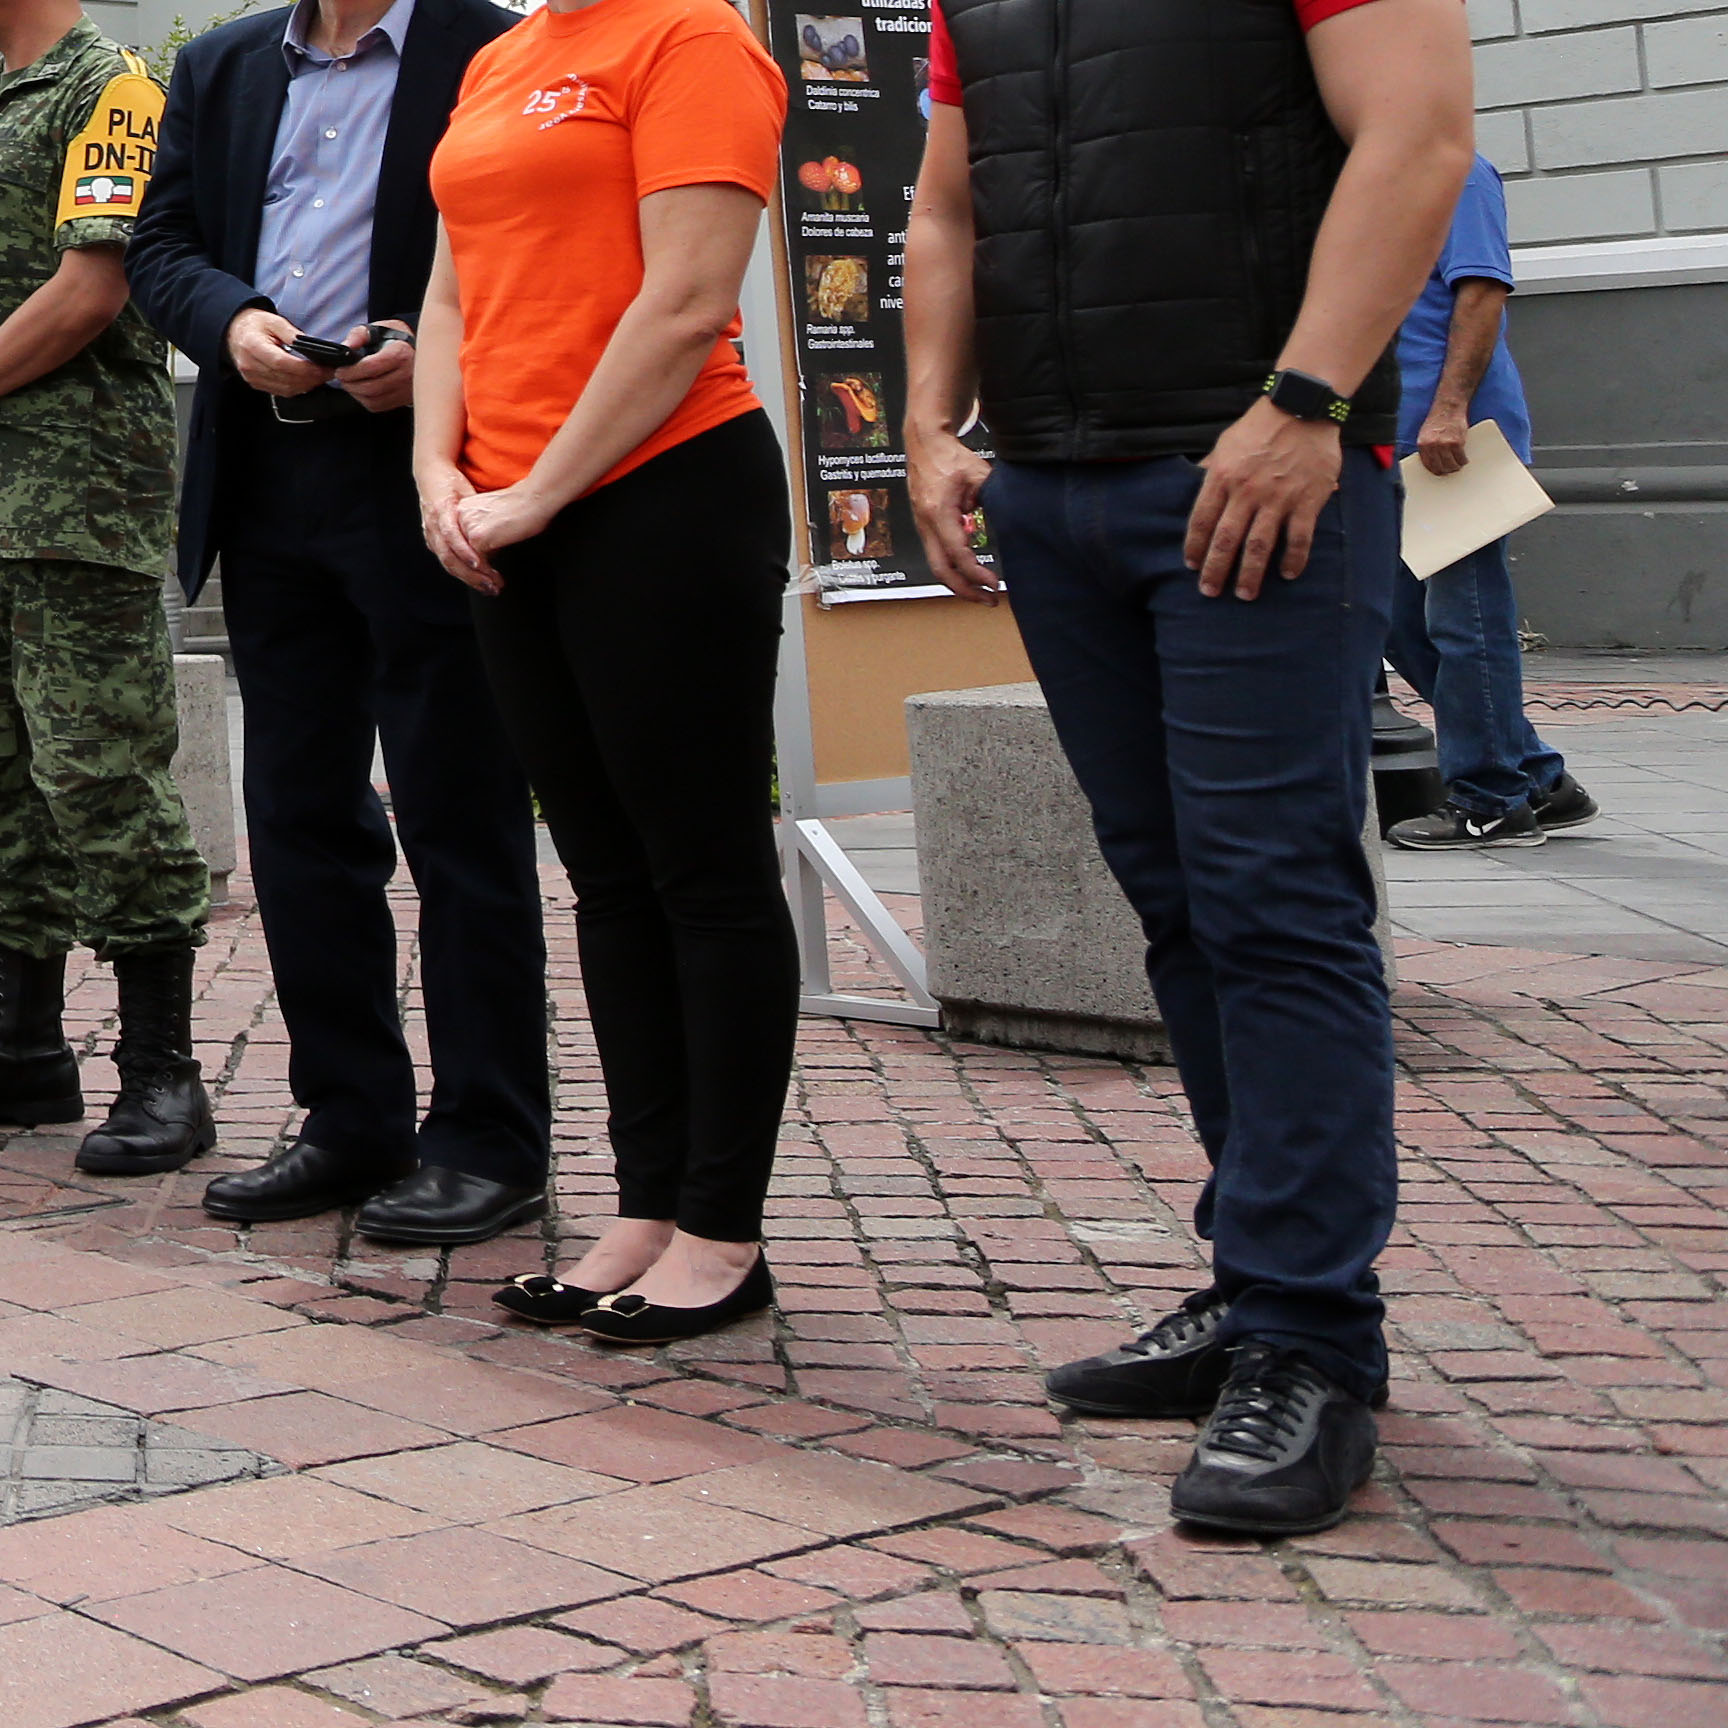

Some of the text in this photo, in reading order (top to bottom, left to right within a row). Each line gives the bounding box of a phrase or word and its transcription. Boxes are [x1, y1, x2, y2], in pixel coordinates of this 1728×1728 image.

[837, 102, 843, 114] y
[801, 226, 874, 238] Dolores de cabeza
[853, 470, 860, 482] y
